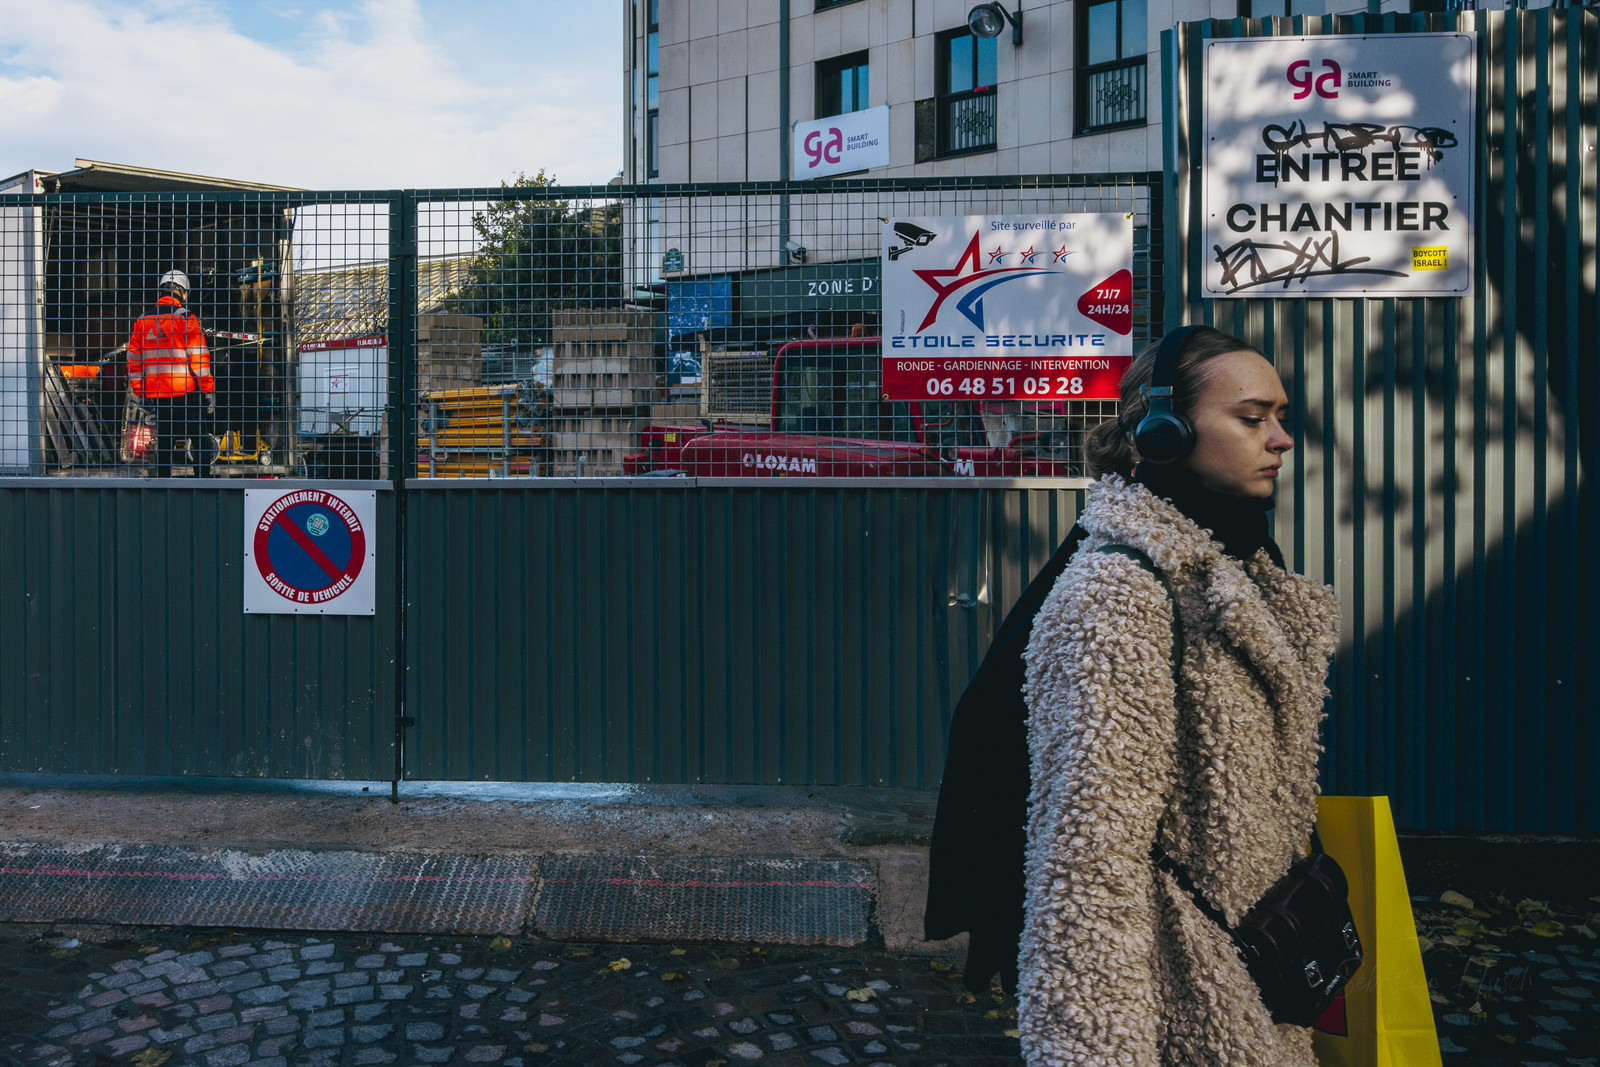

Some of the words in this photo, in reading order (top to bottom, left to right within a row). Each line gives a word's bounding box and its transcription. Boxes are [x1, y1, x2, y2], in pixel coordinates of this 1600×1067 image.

[1347, 71, 1378, 80] SMART
[1347, 79, 1392, 88] BUILDING
[846, 133, 869, 143] SMART
[846, 139, 879, 151] BUILDING
[1256, 151, 1421, 183] ENTREE
[1225, 201, 1450, 233] CHANTIER
[990, 221, 1011, 231] Site
[1012, 220, 1056, 231] surveillé
[1058, 222, 1076, 233] par
[1413, 249, 1448, 258] BOYCOTT
[1413, 259, 1442, 268] ISRAEL
[808, 280, 854, 296] ZONE
[1096, 288, 1120, 300] 7J/7
[1087, 303, 1130, 315] 24H/24
[891, 335, 976, 348] ETOILE
[985, 333, 1106, 347] SECURITE
[897, 361, 935, 371] RONDE
[943, 360, 1022, 371] GARDIENNAGE
[1030, 359, 1110, 371] INTERVENTION
[926, 378, 953, 395] 06
[958, 378, 986, 395] 48
[991, 377, 1015, 394] 51
[1023, 377, 1050, 394] 05
[1056, 376, 1083, 394] 28
[259, 491, 326, 532] STATIONNEMENT
[327, 497, 361, 533] INTERDIT
[265, 572, 296, 599] SORTIE
[297, 591, 310, 602] DE
[312, 573, 354, 602] VEHICULE
